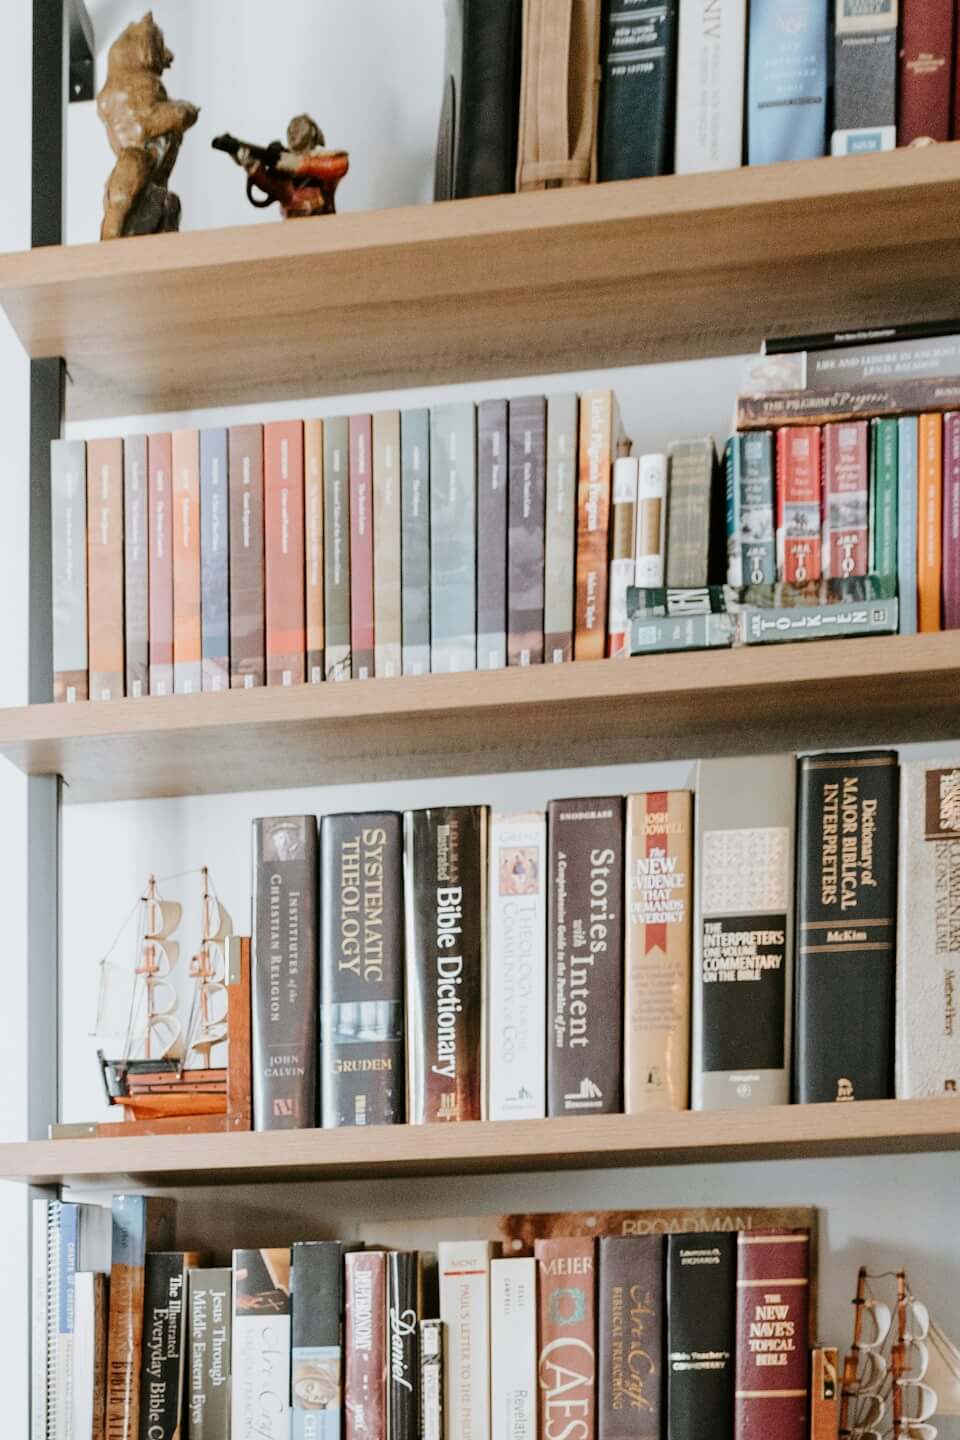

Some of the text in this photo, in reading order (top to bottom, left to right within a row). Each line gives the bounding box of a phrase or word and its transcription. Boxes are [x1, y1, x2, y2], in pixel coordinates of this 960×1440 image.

[586, 484, 600, 531] Progress
[437, 823, 449, 881] Illustrated
[821, 783, 838, 905] INTERPRETERS
[839, 776, 857, 911] MAJOR BIBLICAL
[857, 799, 878, 886] Dictionary of
[638, 857, 678, 876] NEW
[336, 835, 361, 977] THEOLOGY
[360, 828, 387, 982] SYSTEMATIC
[589, 848, 614, 953] Stories
[642, 887, 672, 901] THAT
[934, 843, 947, 955] IN ONE VOLUME
[947, 842, 960, 953] COMMENTARY
[269, 873, 282, 1022] CHRISTIAN RELIGION
[703, 930, 785, 948] INTERPRETER'S
[704, 922, 723, 935] THE
[826, 929, 868, 943] McKim
[431, 886, 463, 1079] Bible Dictionary
[568, 918, 594, 1049] with Intent
[703, 955, 783, 971] COMMENTARY
[703, 969, 762, 983] ON THE BIBLE
[329, 1058, 393, 1072] GRUDEM
[621, 1215, 753, 1238] BROADMAN
[539, 1256, 594, 1277] MEIER
[166, 1273, 182, 1359] The Illustrated
[353, 1269, 372, 1351] DEUTERONOMY
[749, 1321, 796, 1338] NAVE'S
[755, 1305, 790, 1321] NEW
[147, 1307, 168, 1378] Everyday
[188, 1289, 206, 1424] Middle Eastern Eyes
[208, 1289, 226, 1386] Jesus Through
[390, 1307, 417, 1392] Daniel
[460, 1321, 471, 1360] LETTER
[611, 1286, 623, 1409] BIBLICAL PREACHING
[748, 1337, 796, 1353] TOPICAL
[755, 1353, 789, 1367] BIBLE
[109, 1360, 134, 1406] BIBLE
[460, 1363, 471, 1379] TO
[461, 1382, 472, 1404] THE
[148, 1382, 164, 1422] Bible
